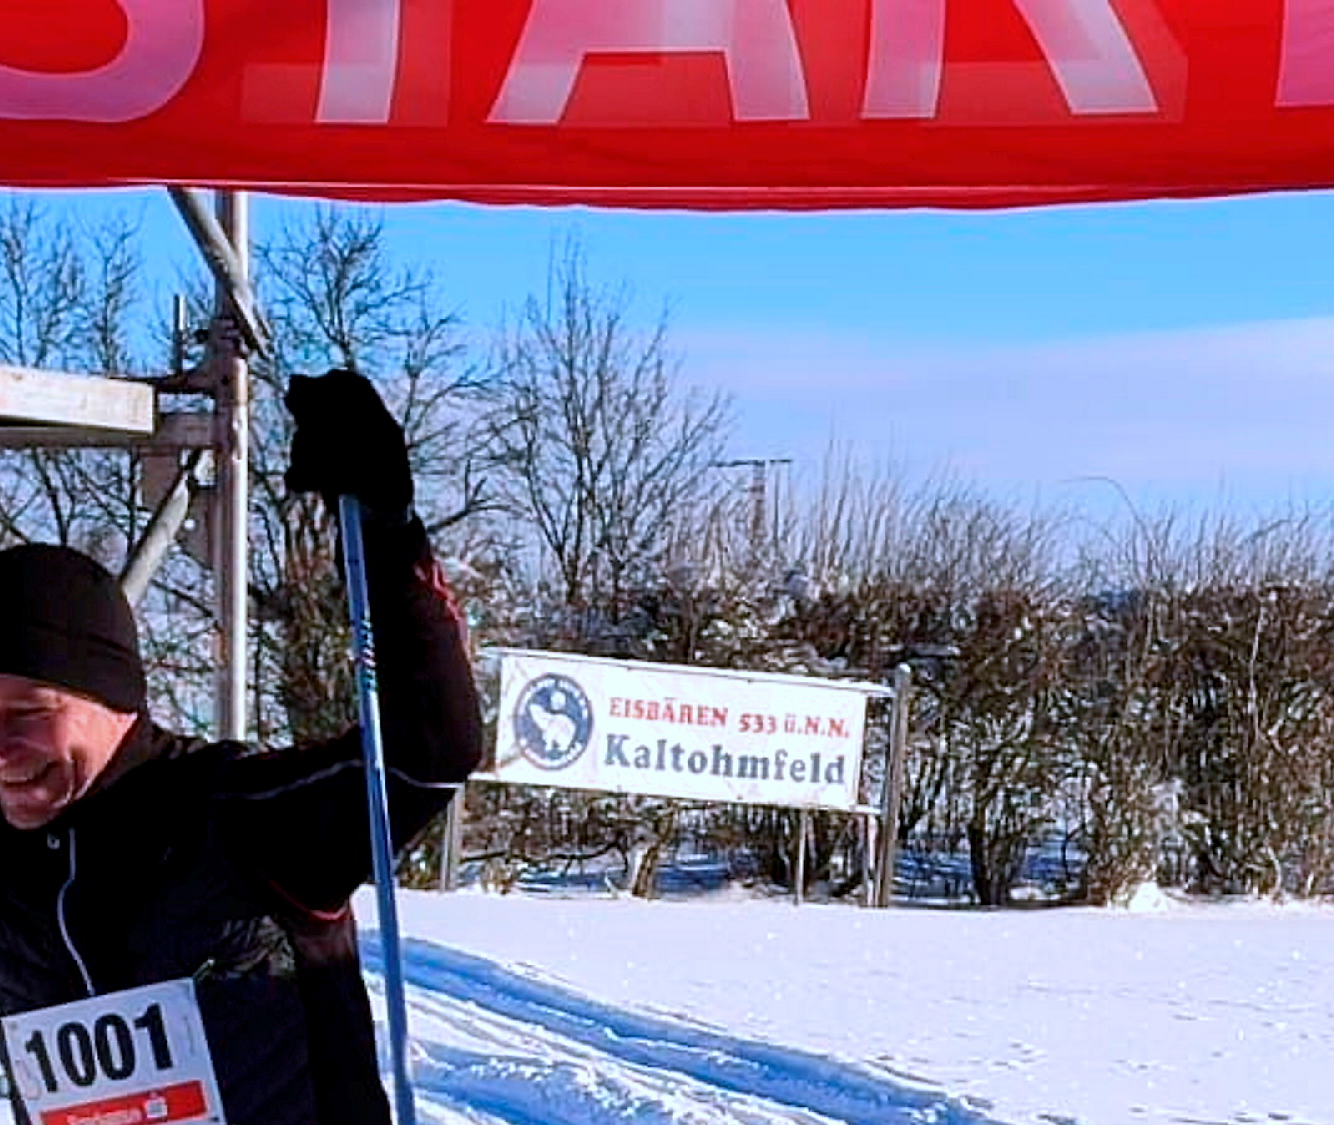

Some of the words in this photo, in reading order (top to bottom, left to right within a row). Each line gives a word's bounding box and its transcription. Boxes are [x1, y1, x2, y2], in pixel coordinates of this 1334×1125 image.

[609, 697, 728, 727] EISBÄREN
[738, 713, 777, 735] 533
[604, 733, 845, 783] Kaltohmfeld
[25, 1002, 173, 1093] 1001
